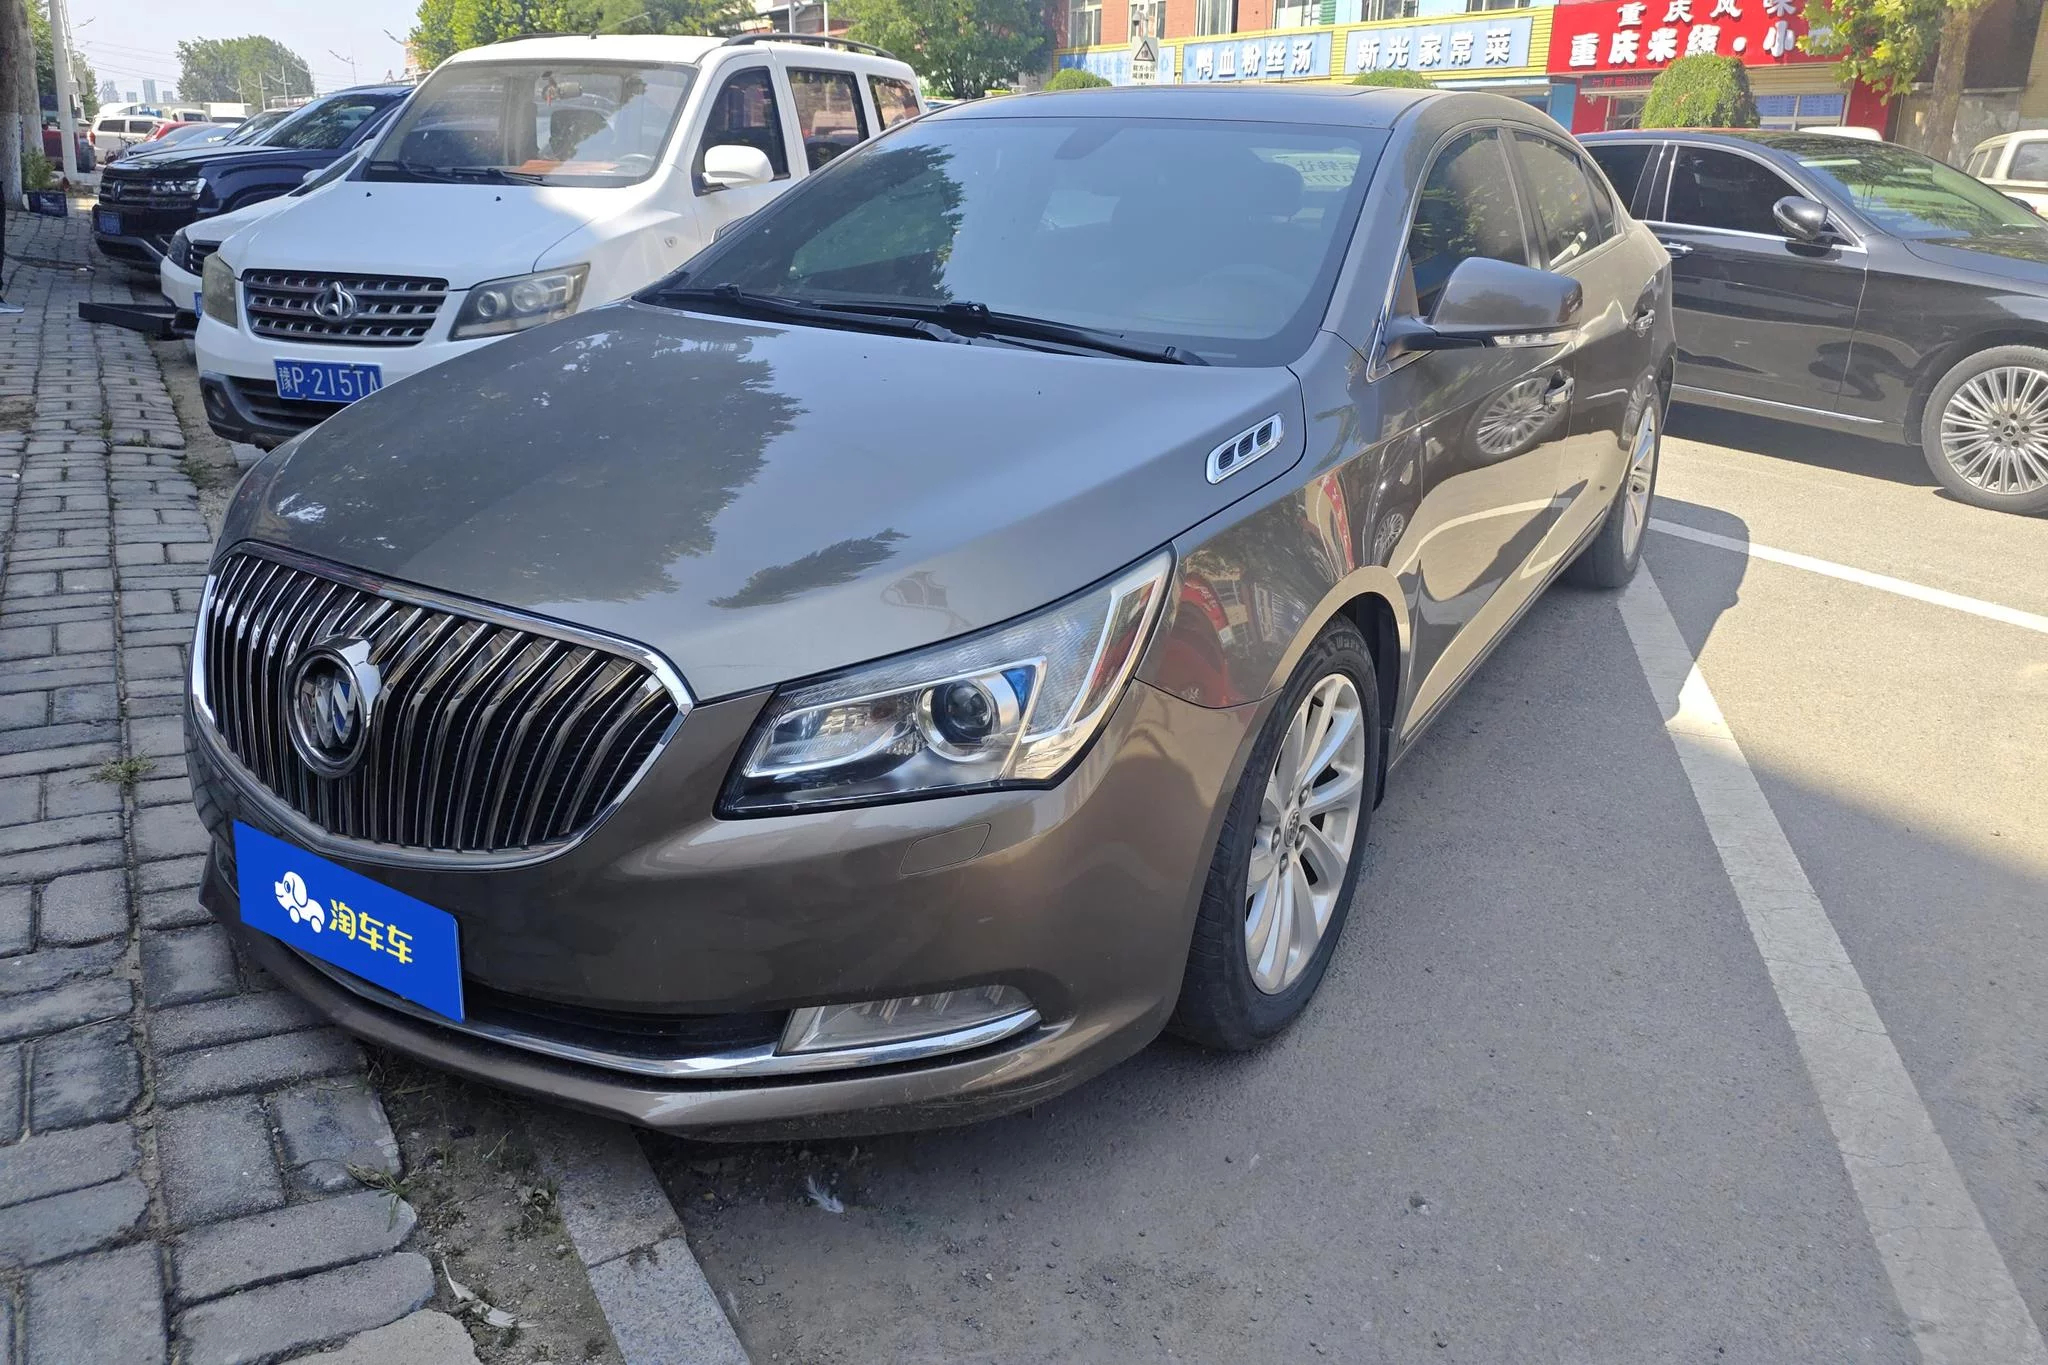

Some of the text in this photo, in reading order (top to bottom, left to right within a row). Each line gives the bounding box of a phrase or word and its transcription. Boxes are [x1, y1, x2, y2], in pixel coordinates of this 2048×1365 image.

[1195, 39, 1313, 79] 鸭血粉丝汤
[1357, 28, 1511, 70] 新光家常菜
